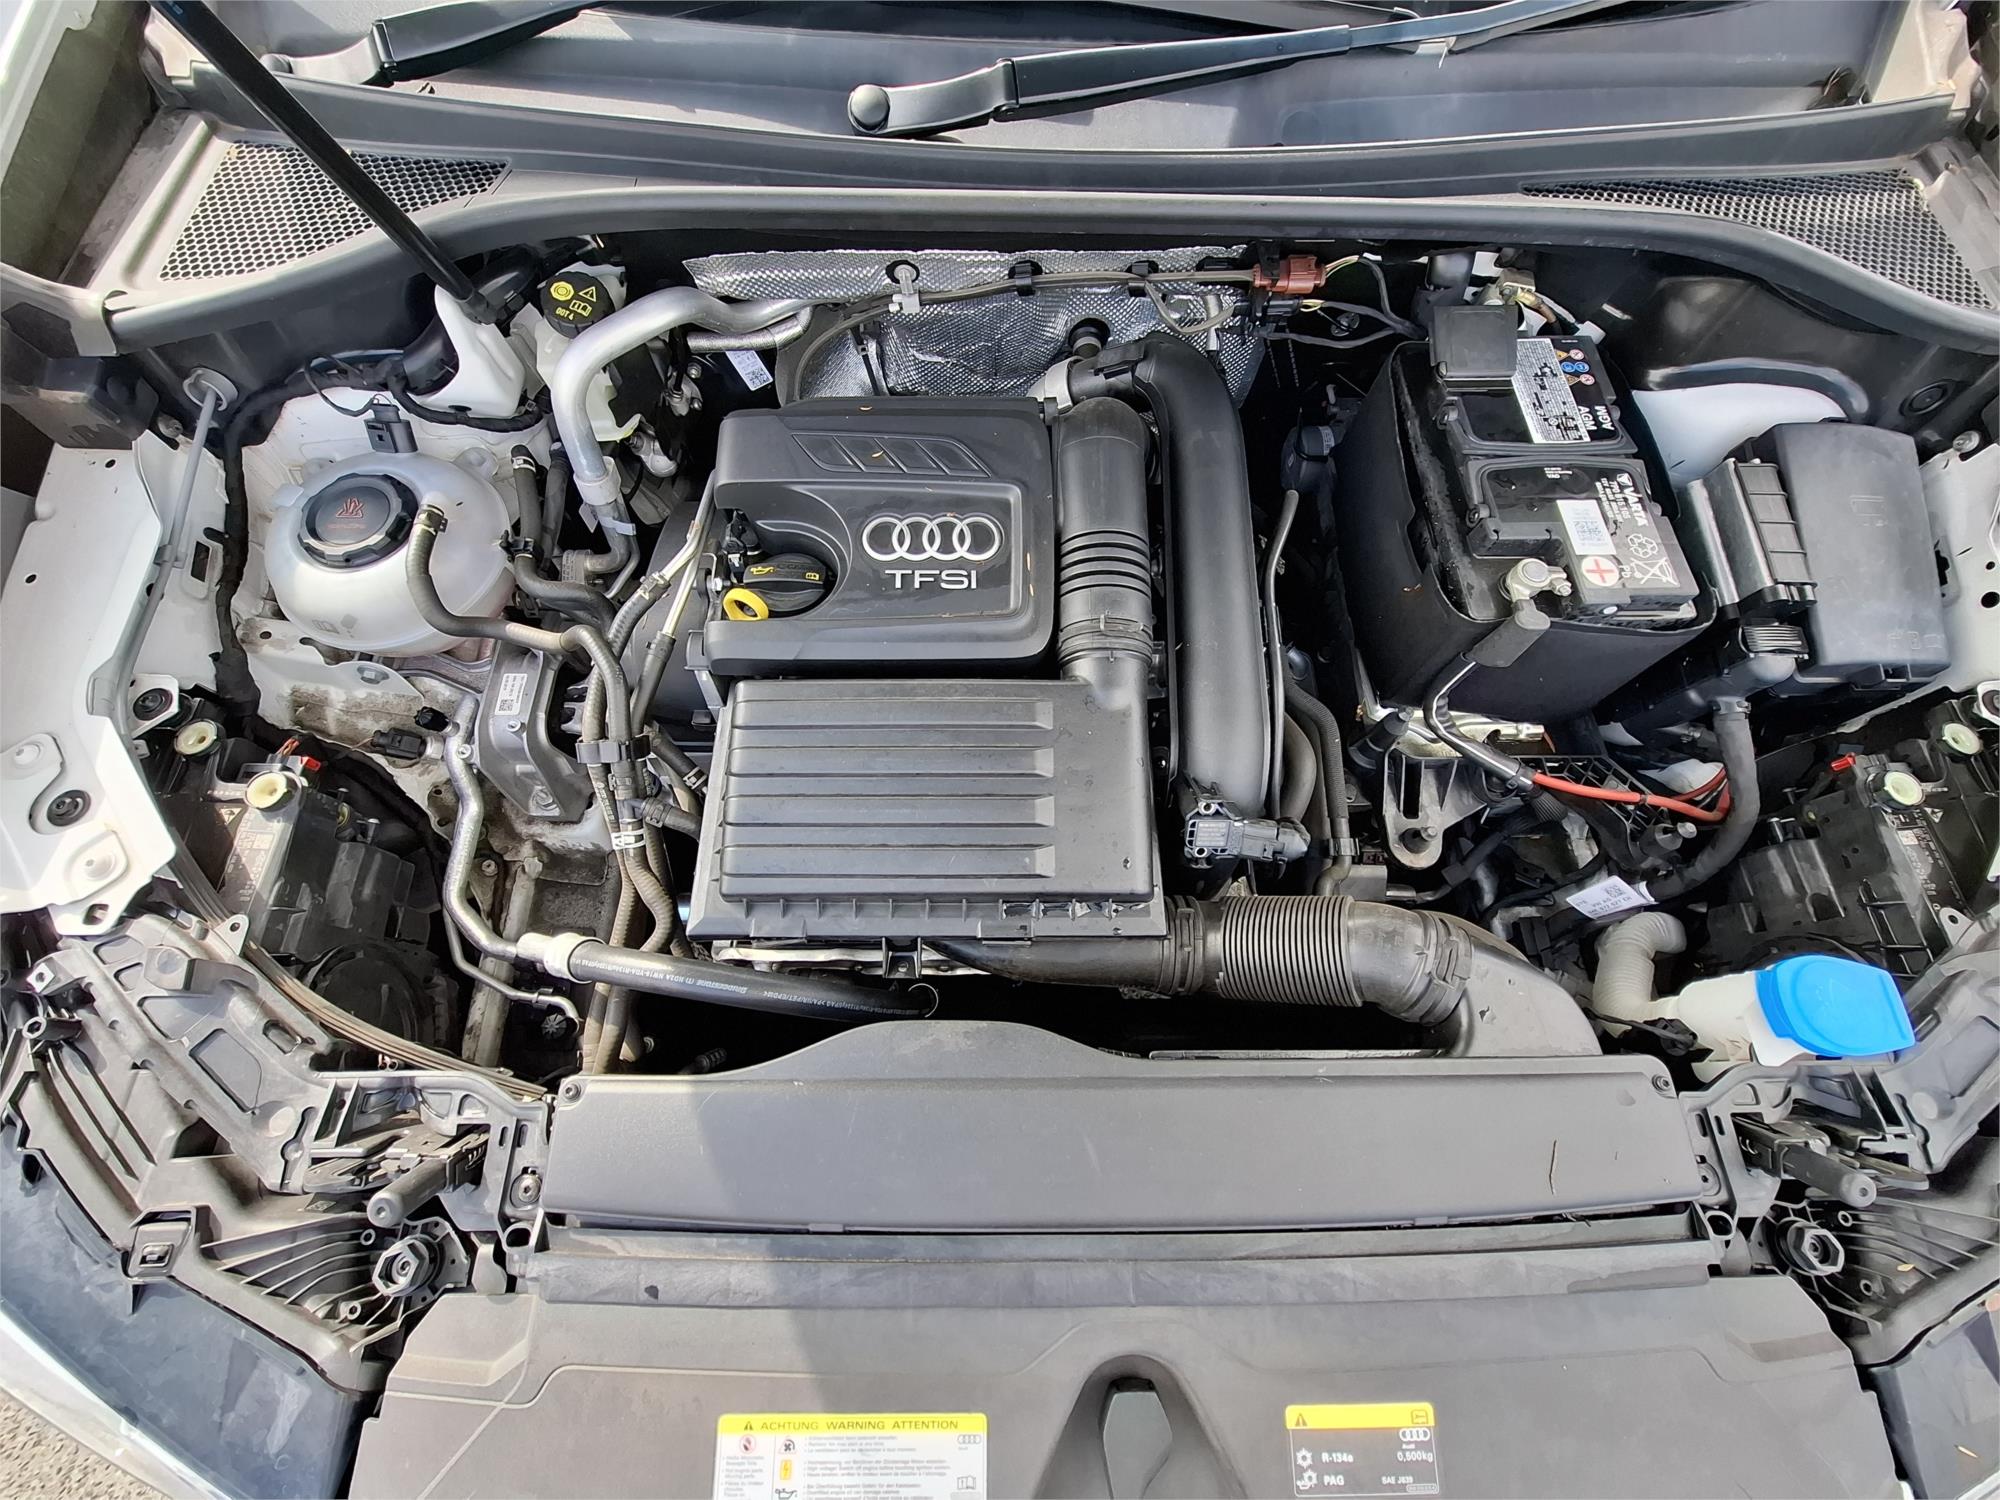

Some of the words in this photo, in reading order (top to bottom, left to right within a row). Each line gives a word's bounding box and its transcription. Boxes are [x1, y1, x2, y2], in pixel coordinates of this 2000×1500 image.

[555, 307, 570, 318] DOT
[1578, 405, 1598, 430] AGM
[1594, 405, 1615, 430] AGM
[1623, 486, 1649, 526] VARTA
[1619, 565, 1632, 578] Pb
[884, 569, 977, 590] TFSI
[760, 1421, 819, 1431] ACHTUNG
[826, 1420, 886, 1430] WARNING
[892, 1419, 959, 1430] ATTENTION
[1321, 1452, 1354, 1463] R-134a
[1323, 1474, 1345, 1486] PAG
[1381, 1476, 1396, 1485] SAE
